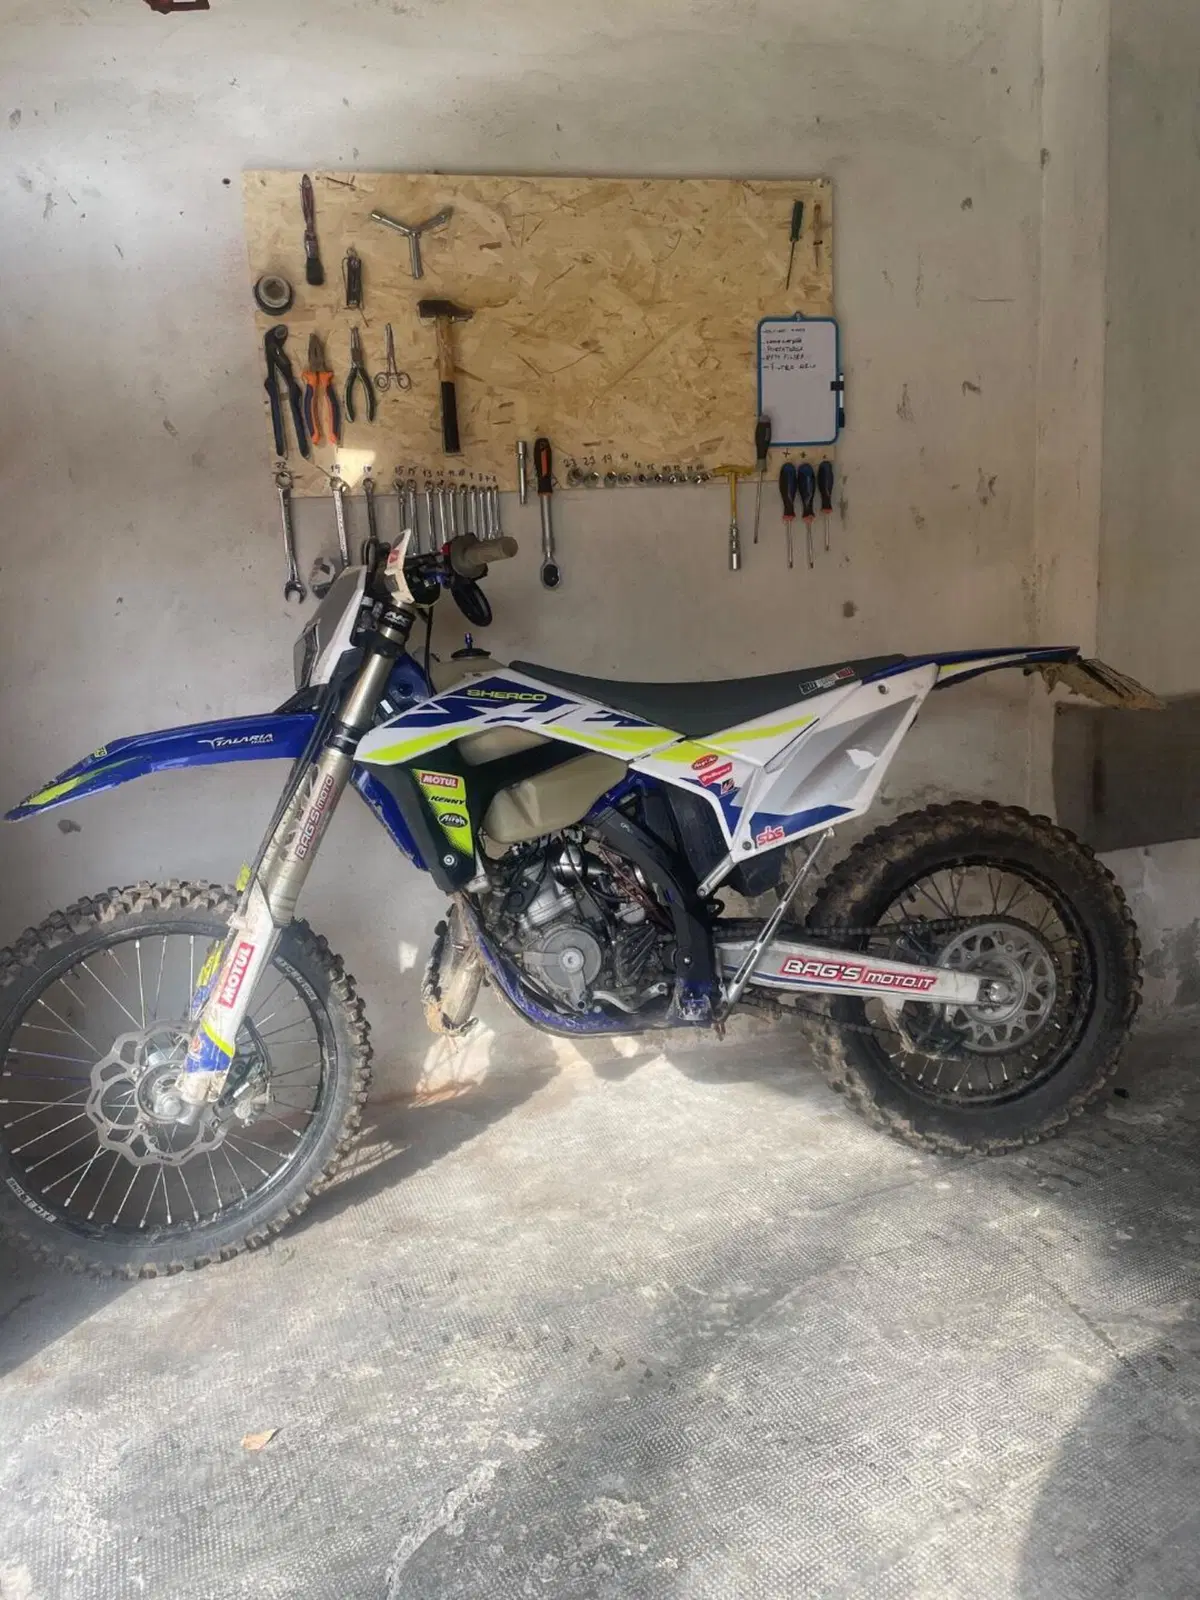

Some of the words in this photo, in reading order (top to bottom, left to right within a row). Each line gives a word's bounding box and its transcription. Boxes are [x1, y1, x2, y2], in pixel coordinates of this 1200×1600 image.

[467, 689, 547, 701] SHERCO
[214, 733, 274, 747] TALARIA
[423, 775, 457, 787] MOTUL
[430, 796, 465, 805] KENNY
[295, 807, 321, 858] BAG'S
[757, 826, 784, 845] sbs
[223, 946, 249, 1003] MOTUL
[783, 959, 862, 980] BAG'S
[865, 972, 934, 989] MOTO.IT
